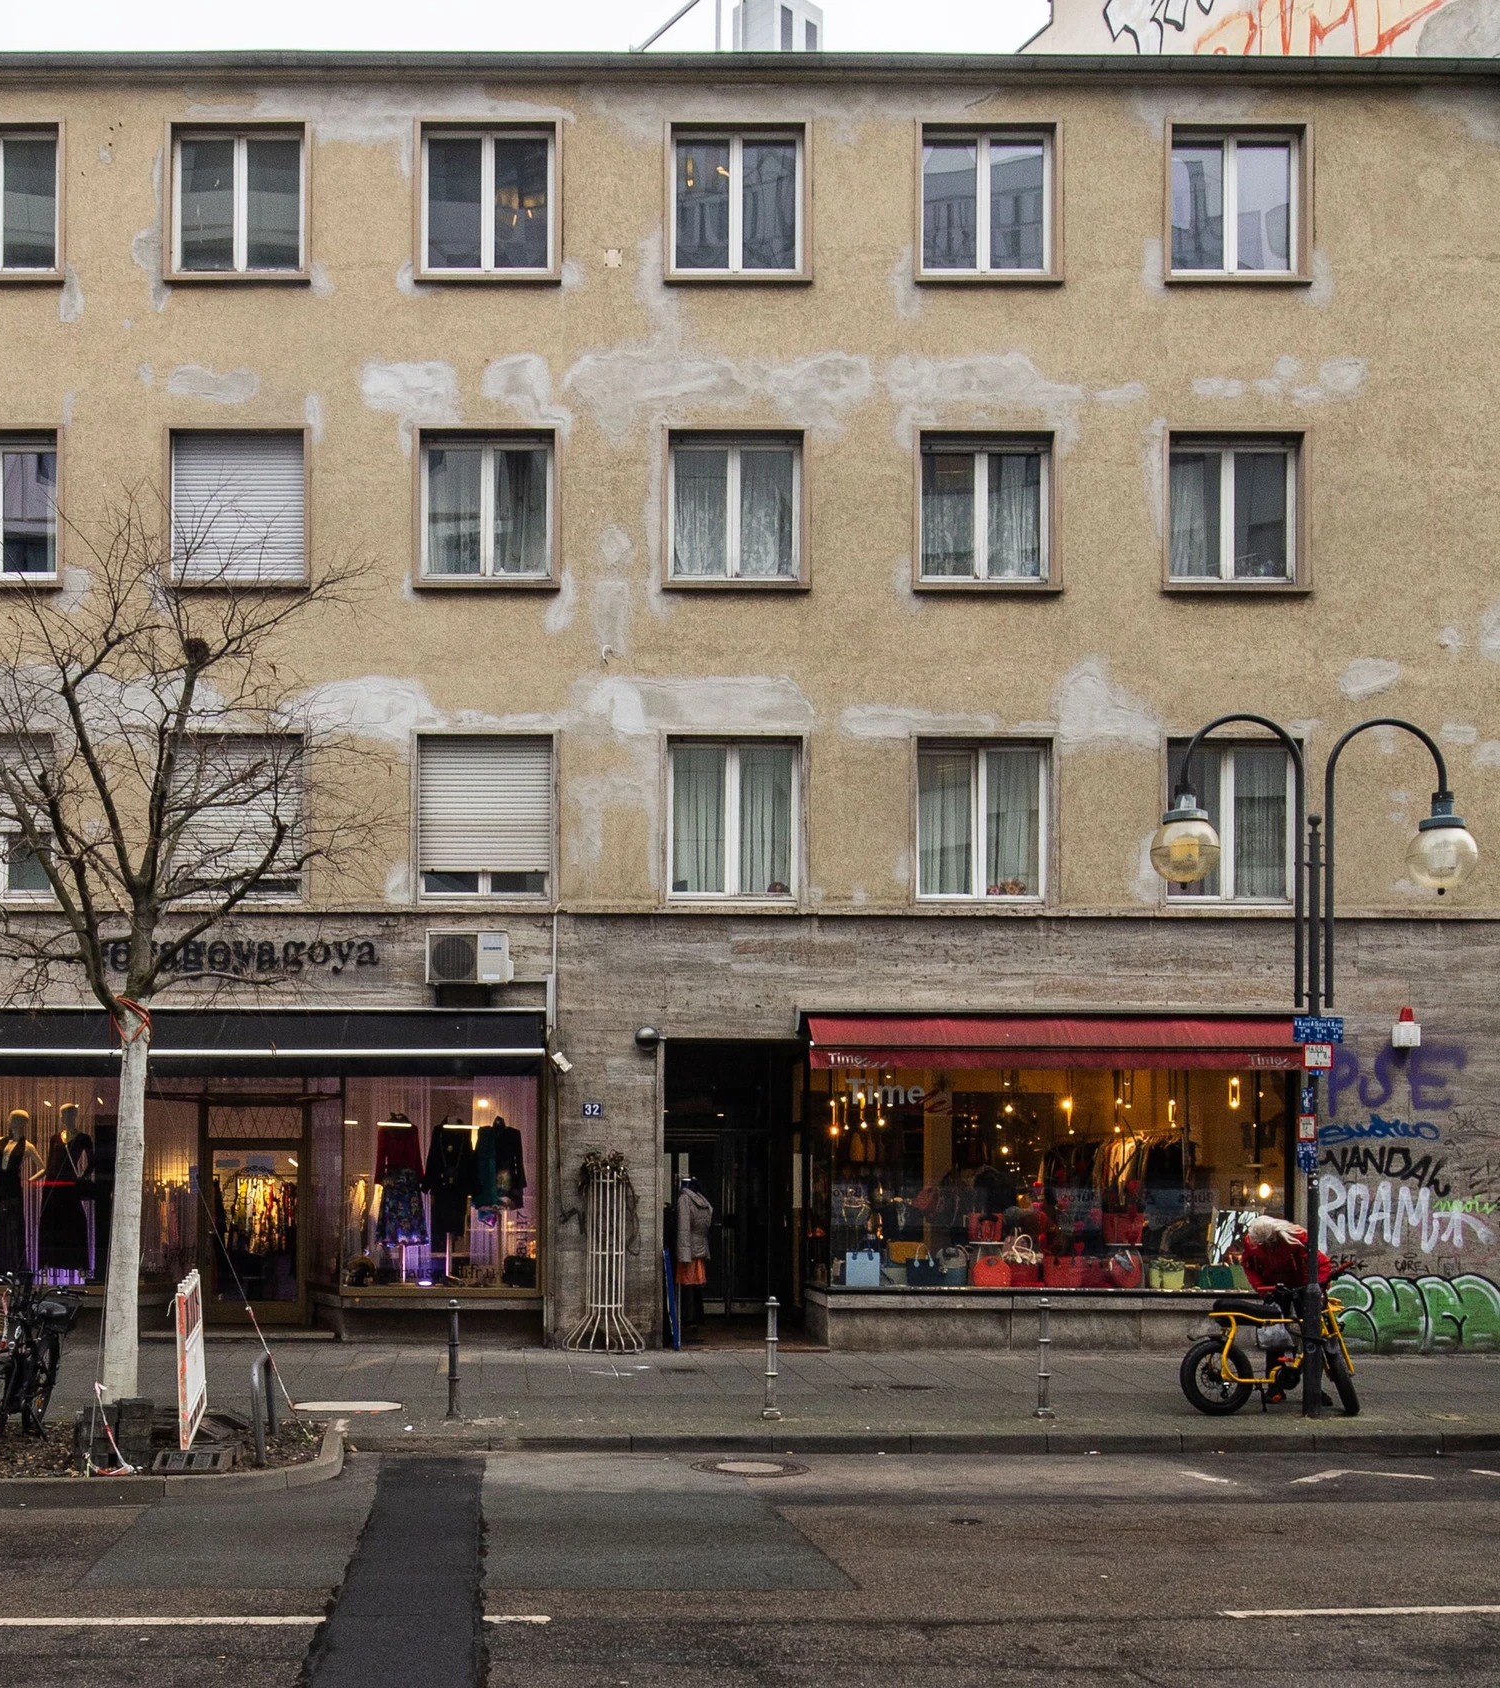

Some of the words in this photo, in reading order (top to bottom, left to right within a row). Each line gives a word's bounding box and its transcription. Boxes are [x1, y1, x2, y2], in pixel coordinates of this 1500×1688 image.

[846, 1078, 926, 1105] Time
[585, 1104, 600, 1115] 32
[1319, 1146, 1451, 1197] VANDAL
